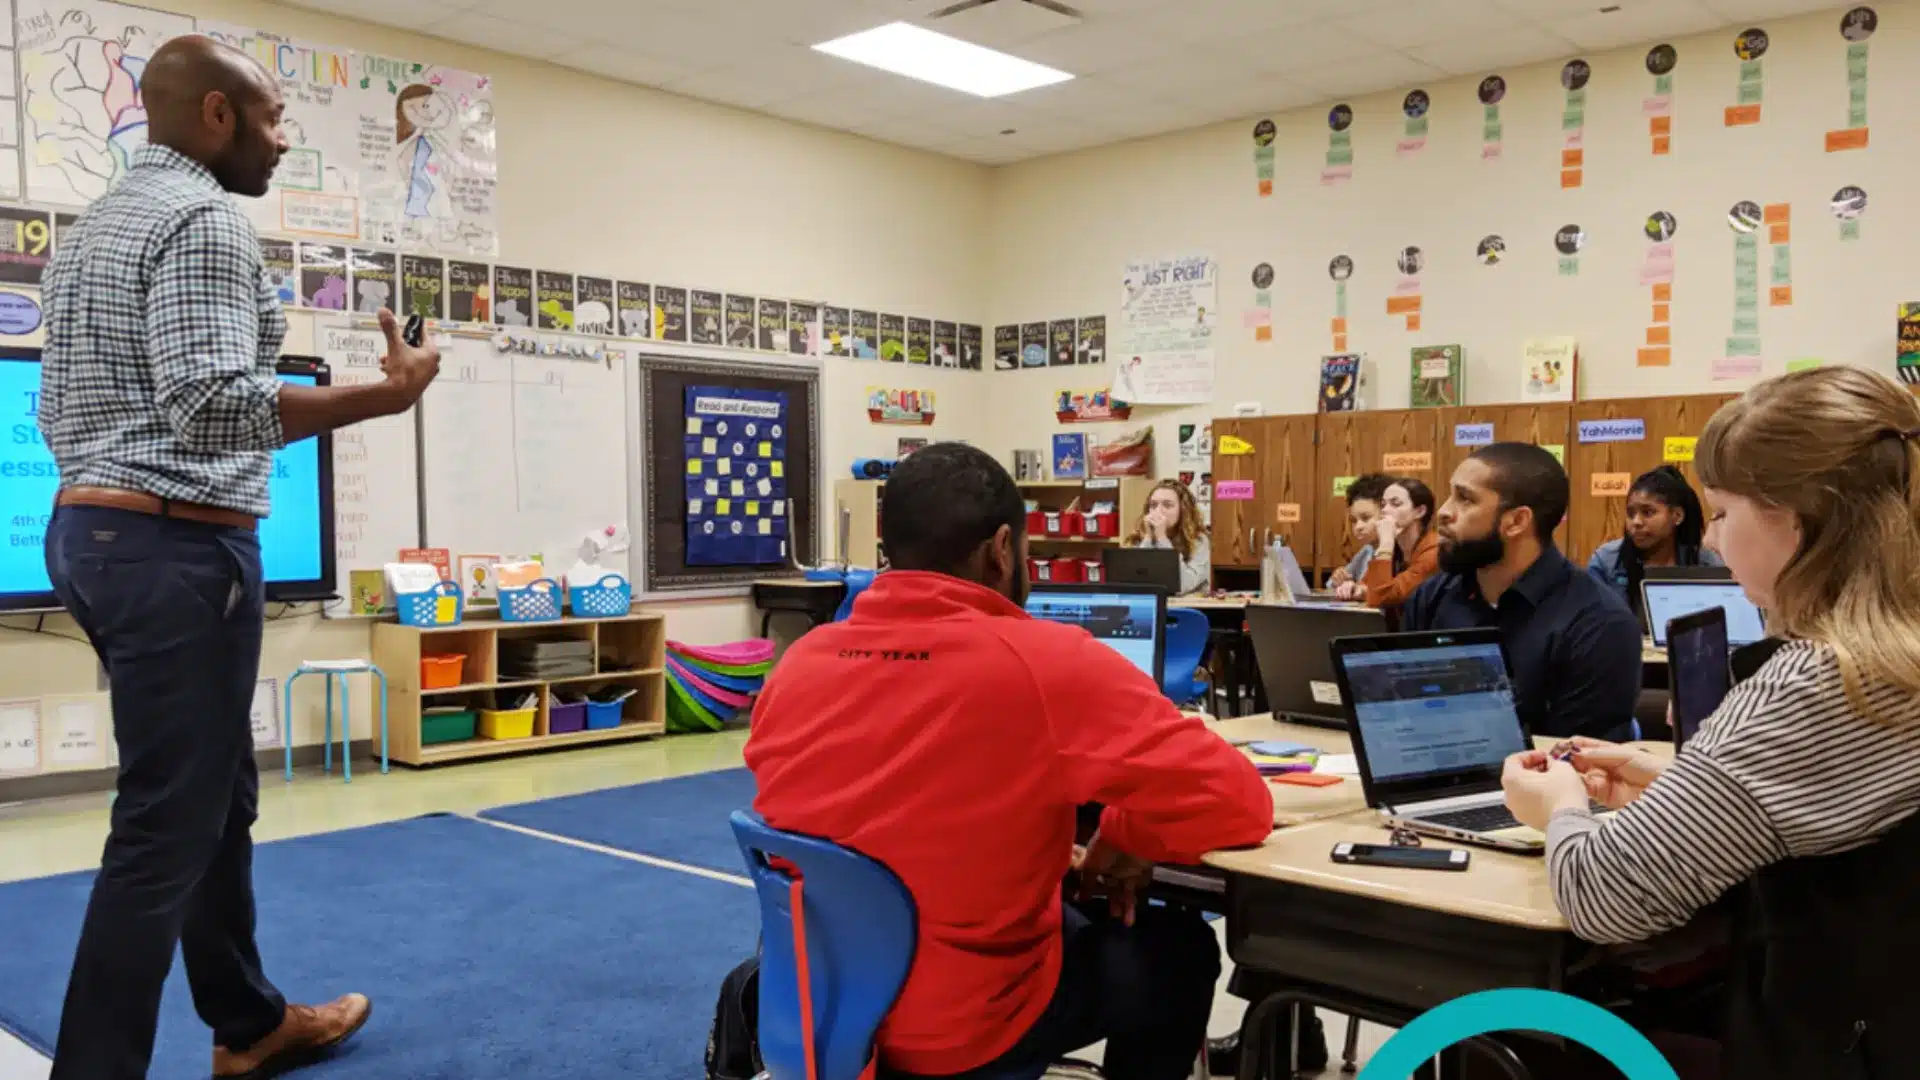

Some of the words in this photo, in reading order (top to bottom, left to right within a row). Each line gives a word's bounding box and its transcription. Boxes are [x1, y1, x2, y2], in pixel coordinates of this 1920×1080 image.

[16, 220, 48, 255] 19
[1143, 268, 1169, 287] JUST
[1173, 259, 1208, 283] RIGHT
[404, 273, 441, 295] frog
[328, 331, 375, 350] Spelling
[24, 391, 39, 415] T
[697, 400, 722, 412] Read
[723, 402, 740, 412] and
[741, 404, 777, 417] Respond
[12, 424, 40, 444] St
[11, 514, 36, 527] 4th
[838, 649, 873, 659] CITY
[880, 651, 930, 661] YEAR
